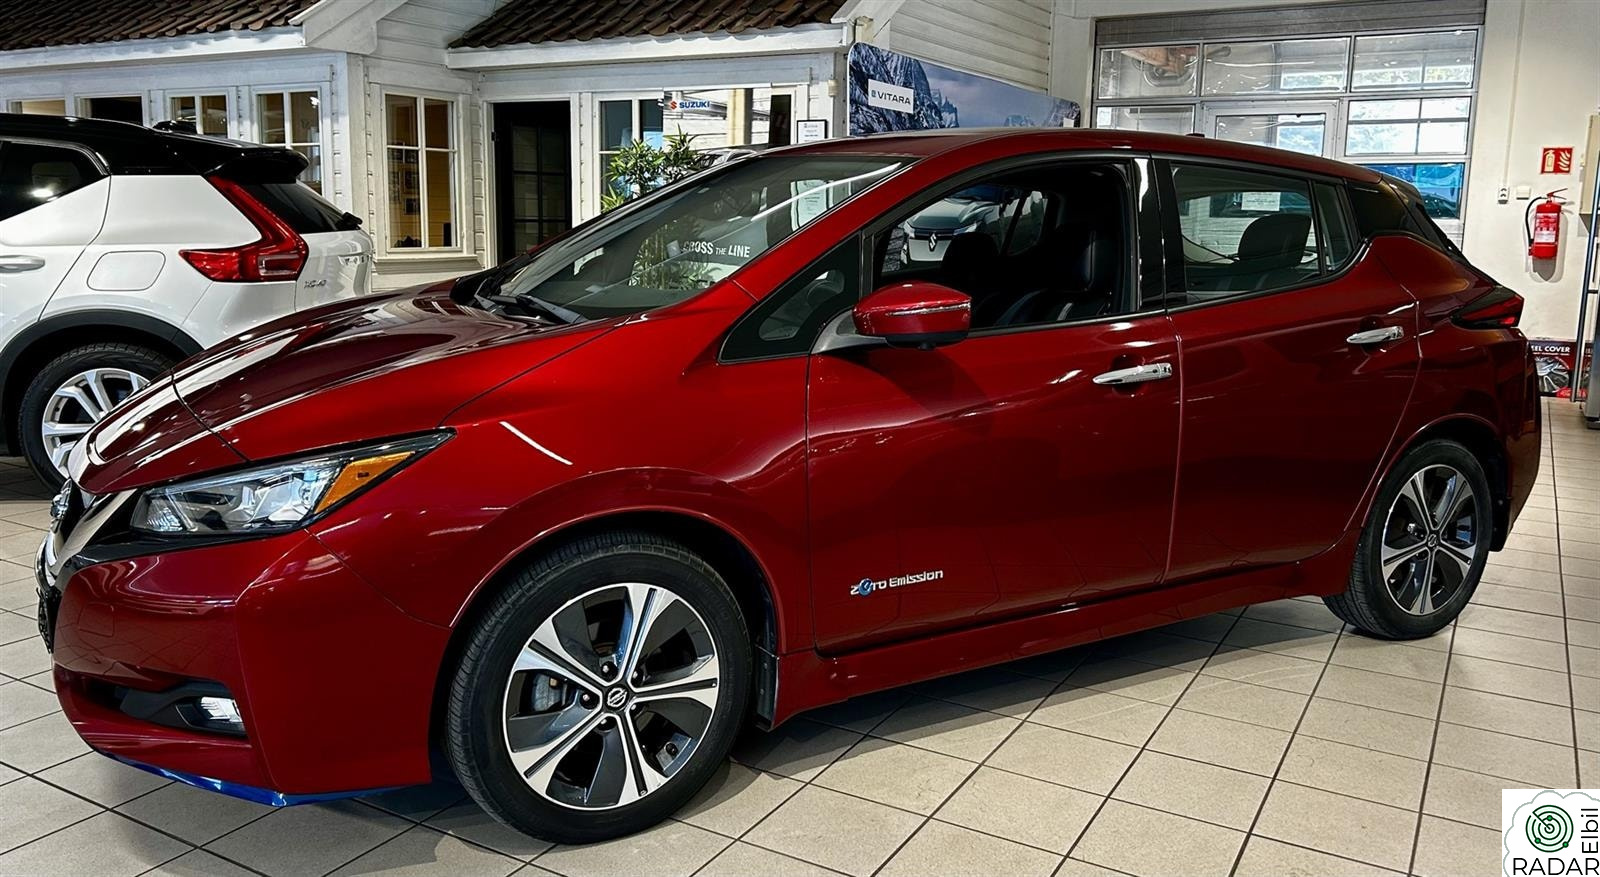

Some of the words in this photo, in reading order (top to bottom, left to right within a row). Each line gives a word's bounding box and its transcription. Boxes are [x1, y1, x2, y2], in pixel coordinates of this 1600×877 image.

[679, 100, 710, 109] SUZUKI
[877, 91, 911, 105] VITARA
[683, 241, 714, 255] CROSS
[715, 247, 727, 255] THE
[728, 244, 751, 258] LINE
[1544, 345, 1571, 353] COVER
[888, 570, 944, 588] Emission
